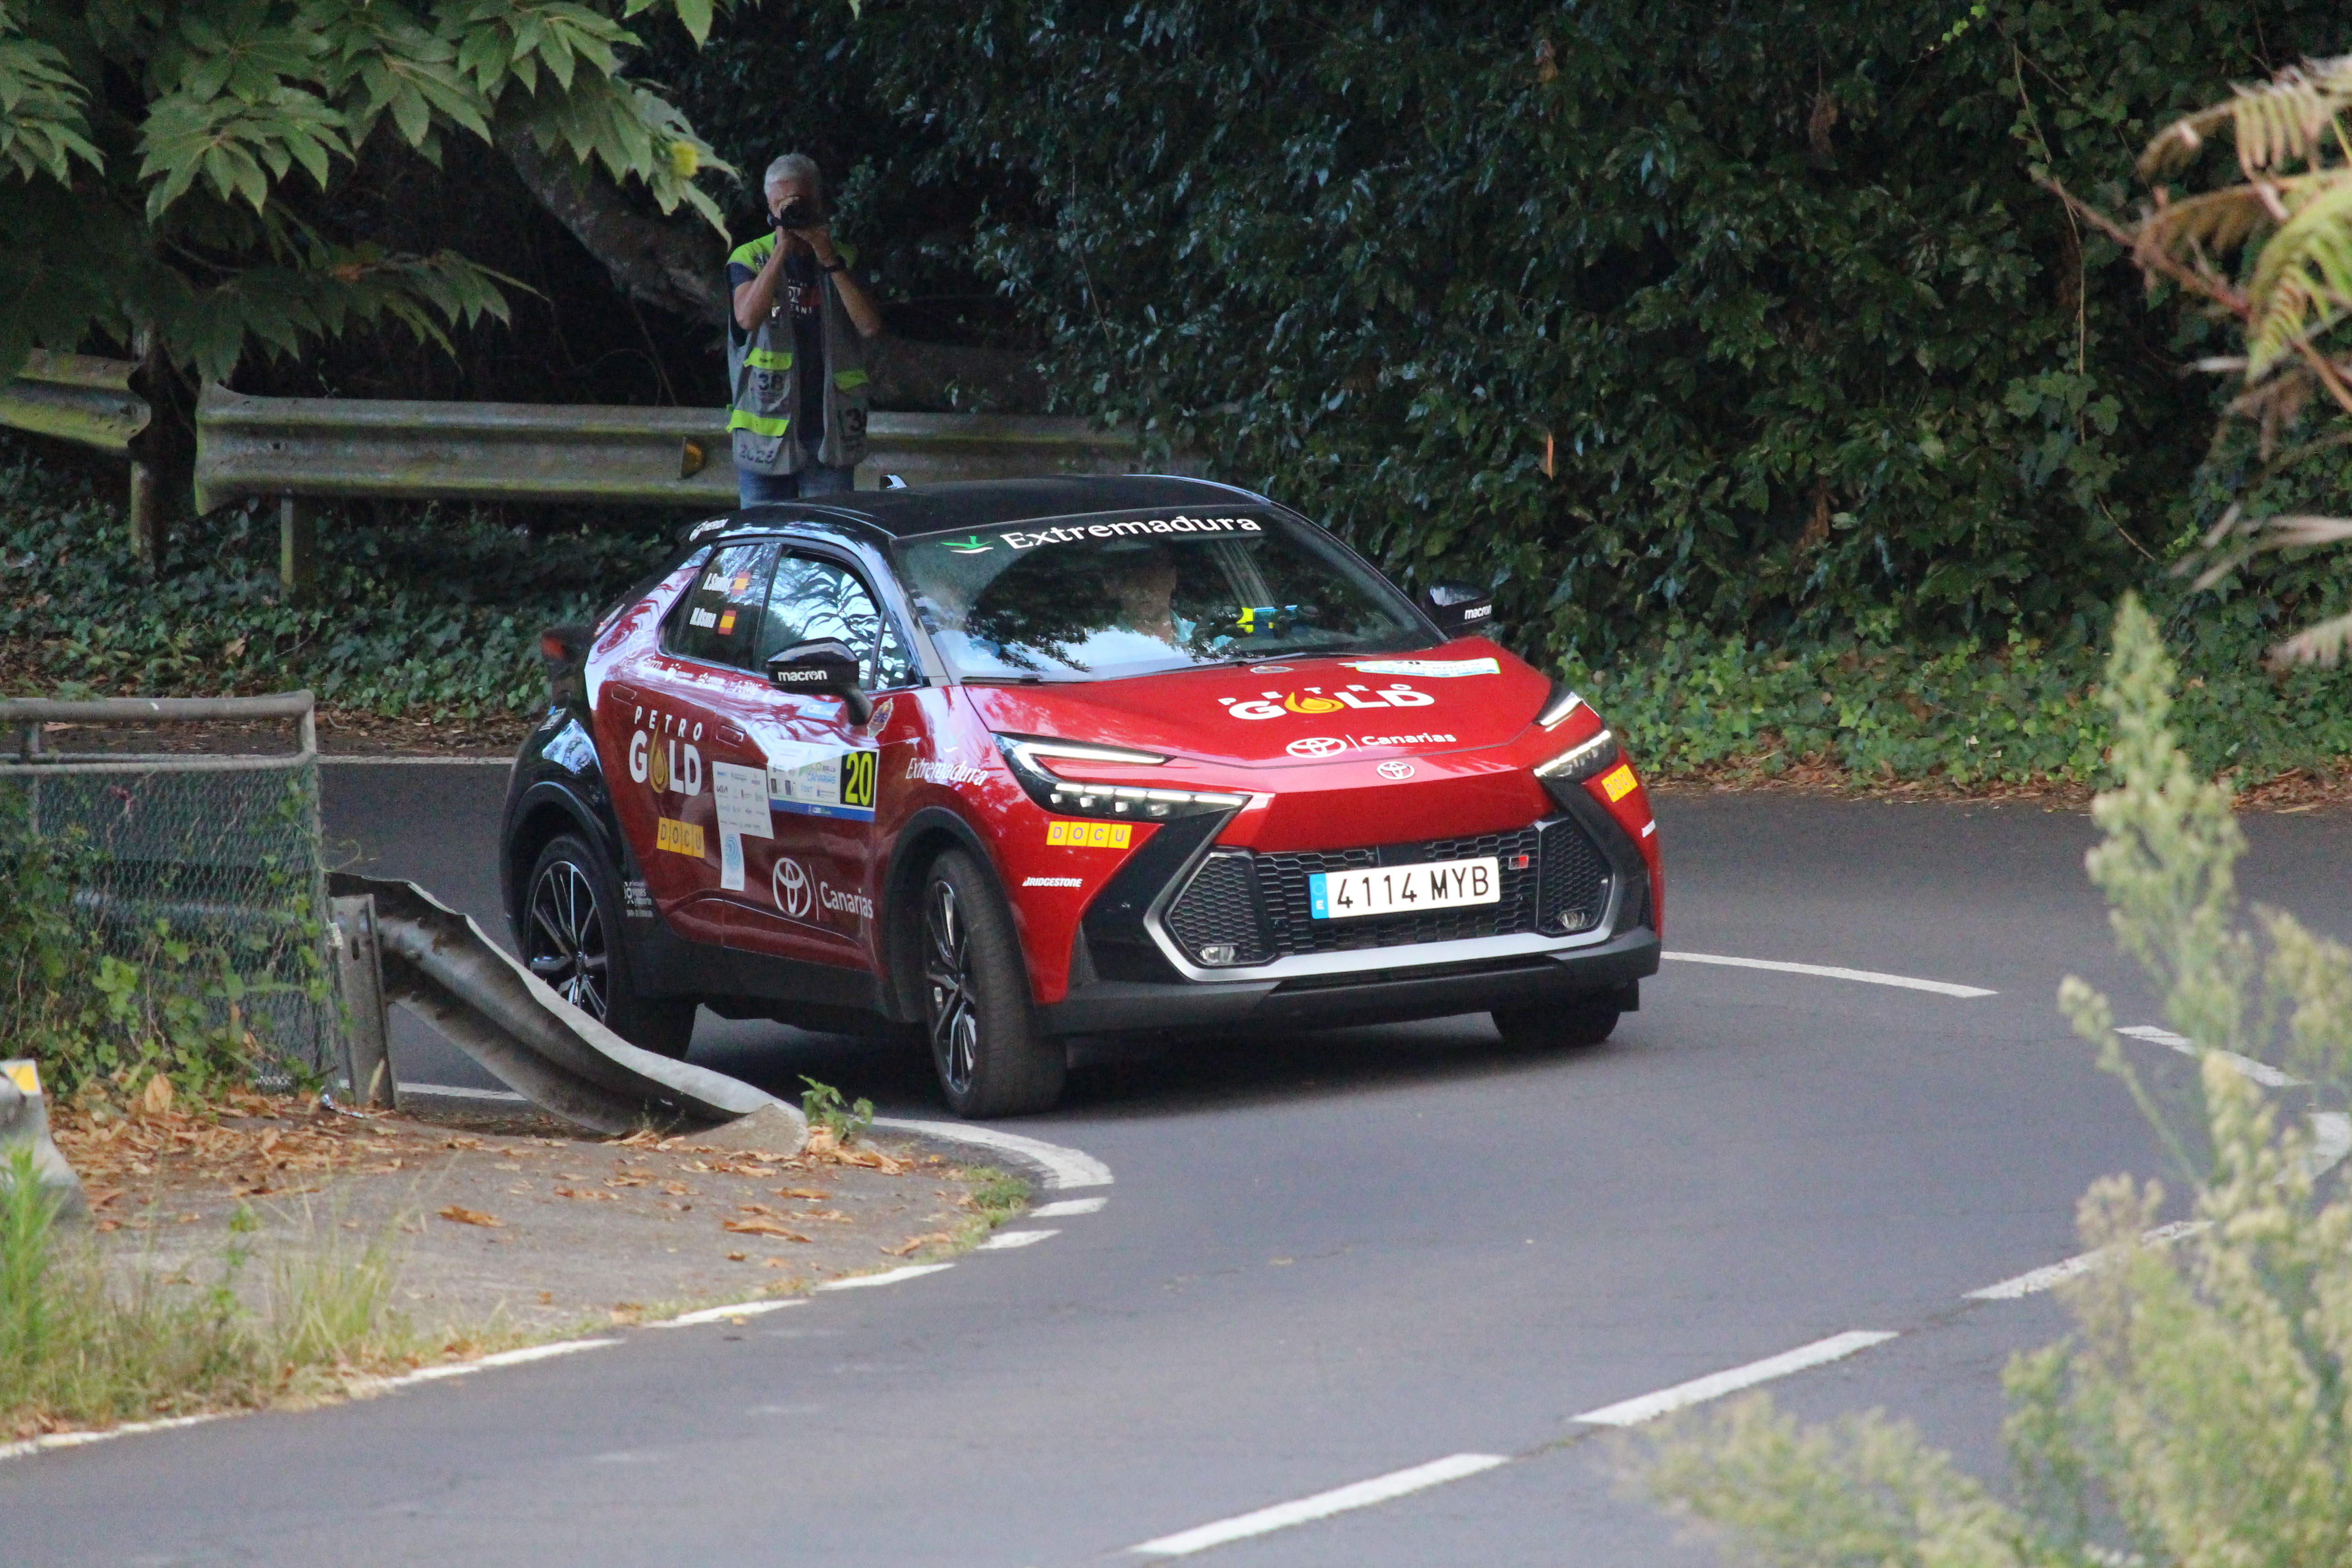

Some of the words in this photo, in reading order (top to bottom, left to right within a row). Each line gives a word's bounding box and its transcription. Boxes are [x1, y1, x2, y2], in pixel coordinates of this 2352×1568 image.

[1000, 515, 1262, 550] Extremadura
[1465, 605, 1492, 620] macron
[778, 670, 828, 682] macron
[1218, 684, 1411, 706] PETRO
[634, 706, 702, 741] PETRO
[1361, 732, 1457, 747] Canarias
[845, 752, 873, 806] 20
[905, 757, 989, 787] Extremadura
[661, 823, 702, 850] DOCU
[1053, 826, 1125, 843] DOCU
[1022, 877, 1083, 887] BRIDGESTONE
[1337, 872, 1417, 909] 4114
[1430, 866, 1490, 901] MYB
[820, 881, 873, 919] Canarias
[1316, 900, 1324, 910] E
